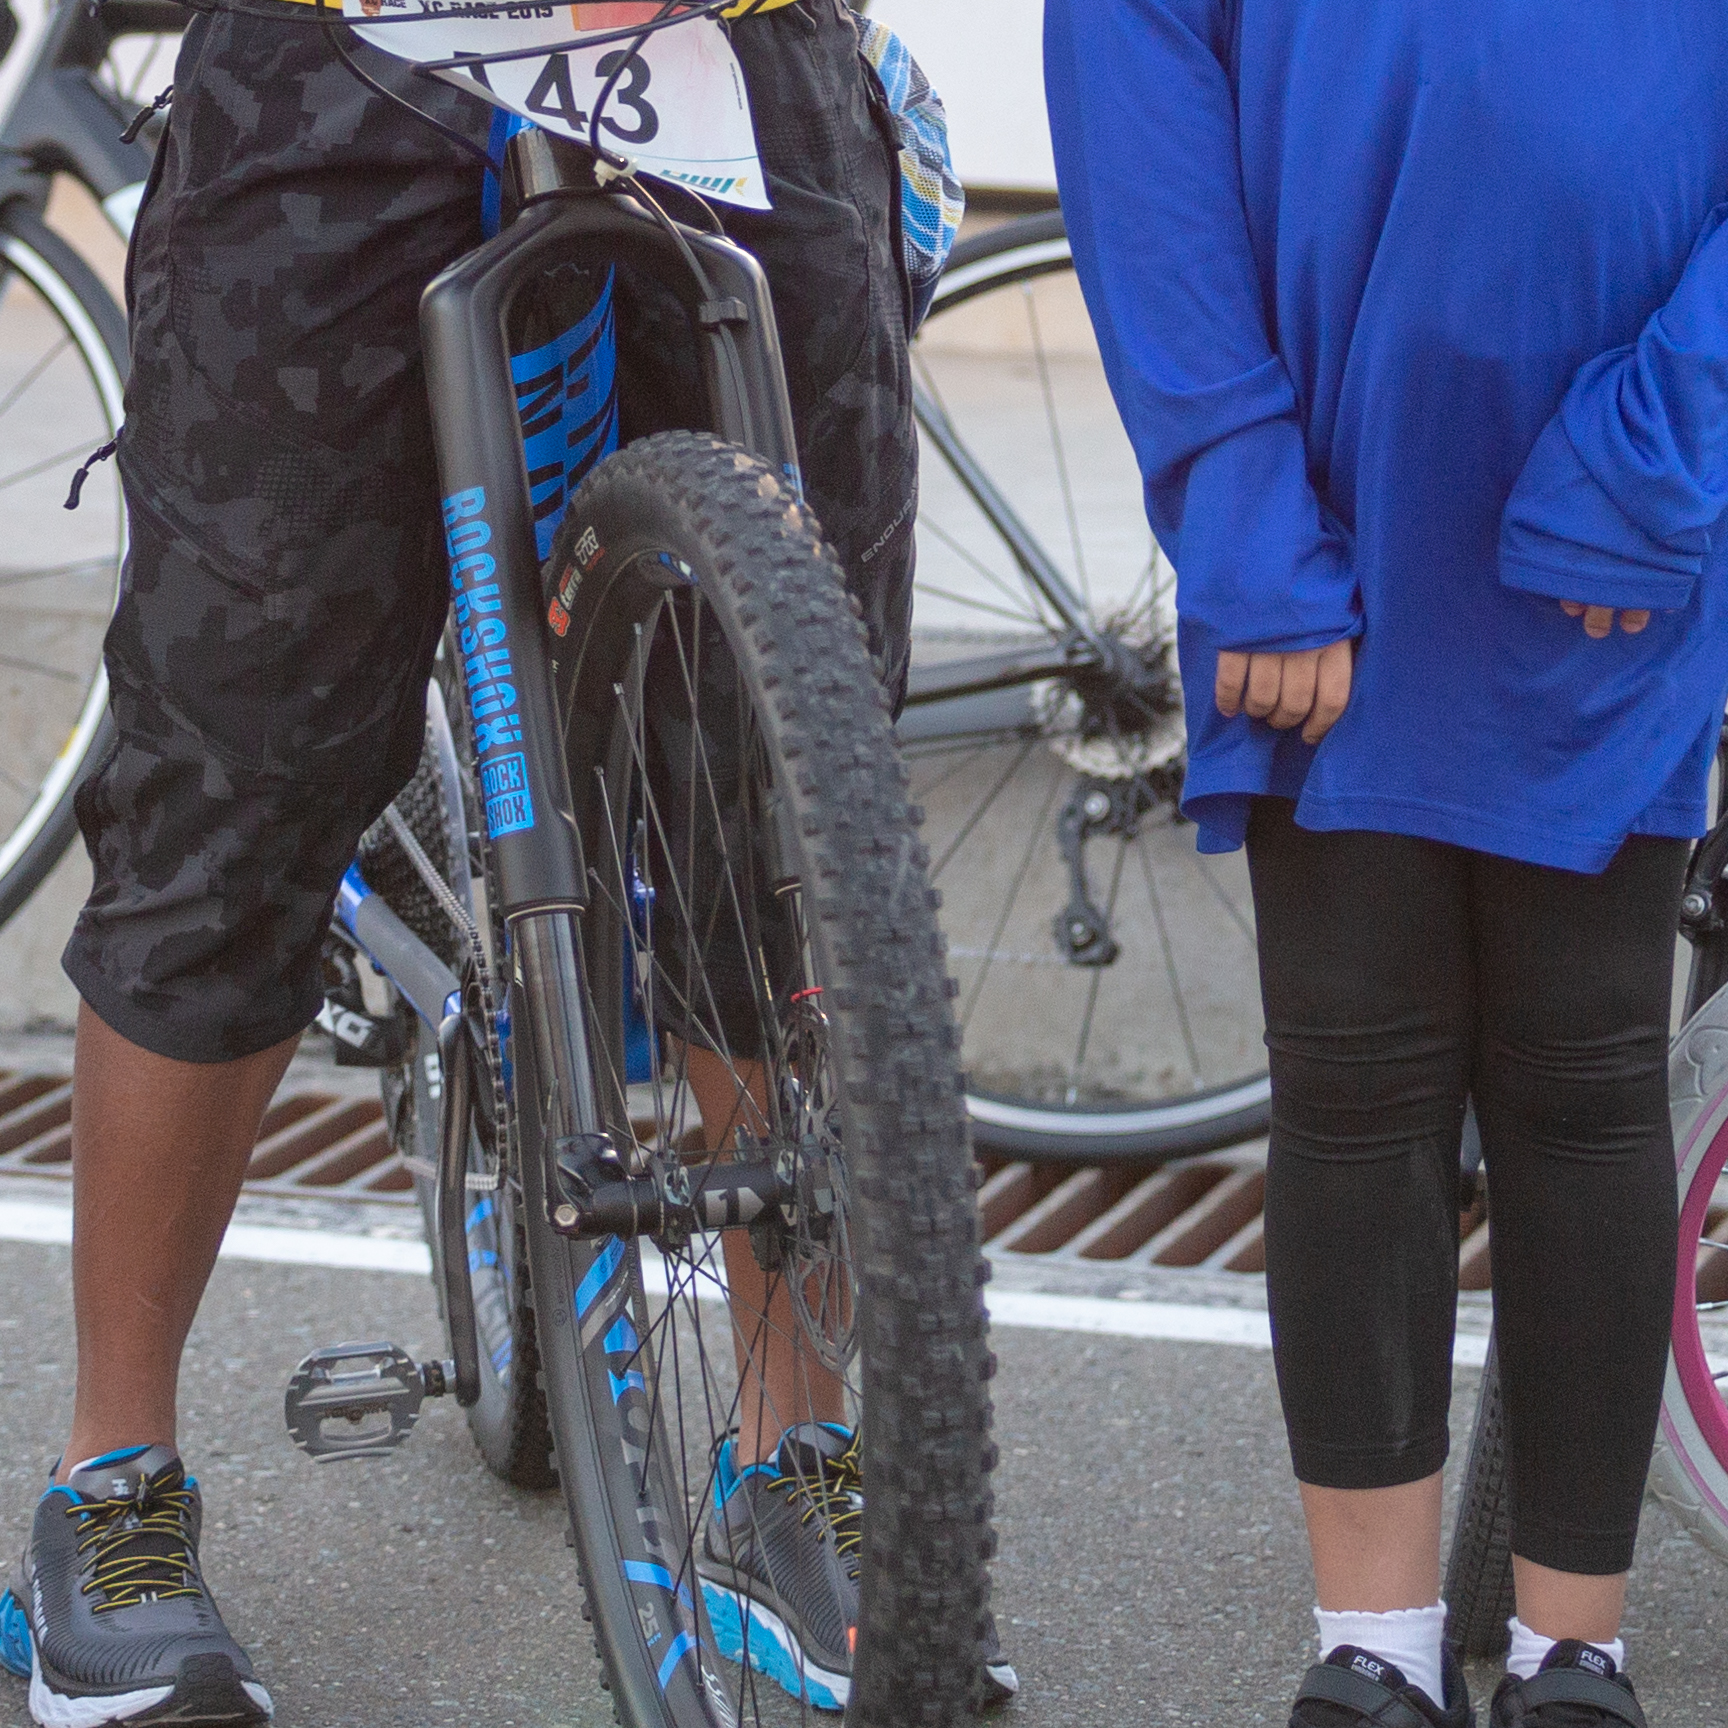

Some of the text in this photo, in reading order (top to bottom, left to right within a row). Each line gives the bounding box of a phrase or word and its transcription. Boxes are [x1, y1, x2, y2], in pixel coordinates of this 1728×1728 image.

[442, 486, 522, 753] ROCKSHOX
[1353, 1655, 1384, 1674] FLEX
[1580, 1649, 1607, 1669] FLEX
